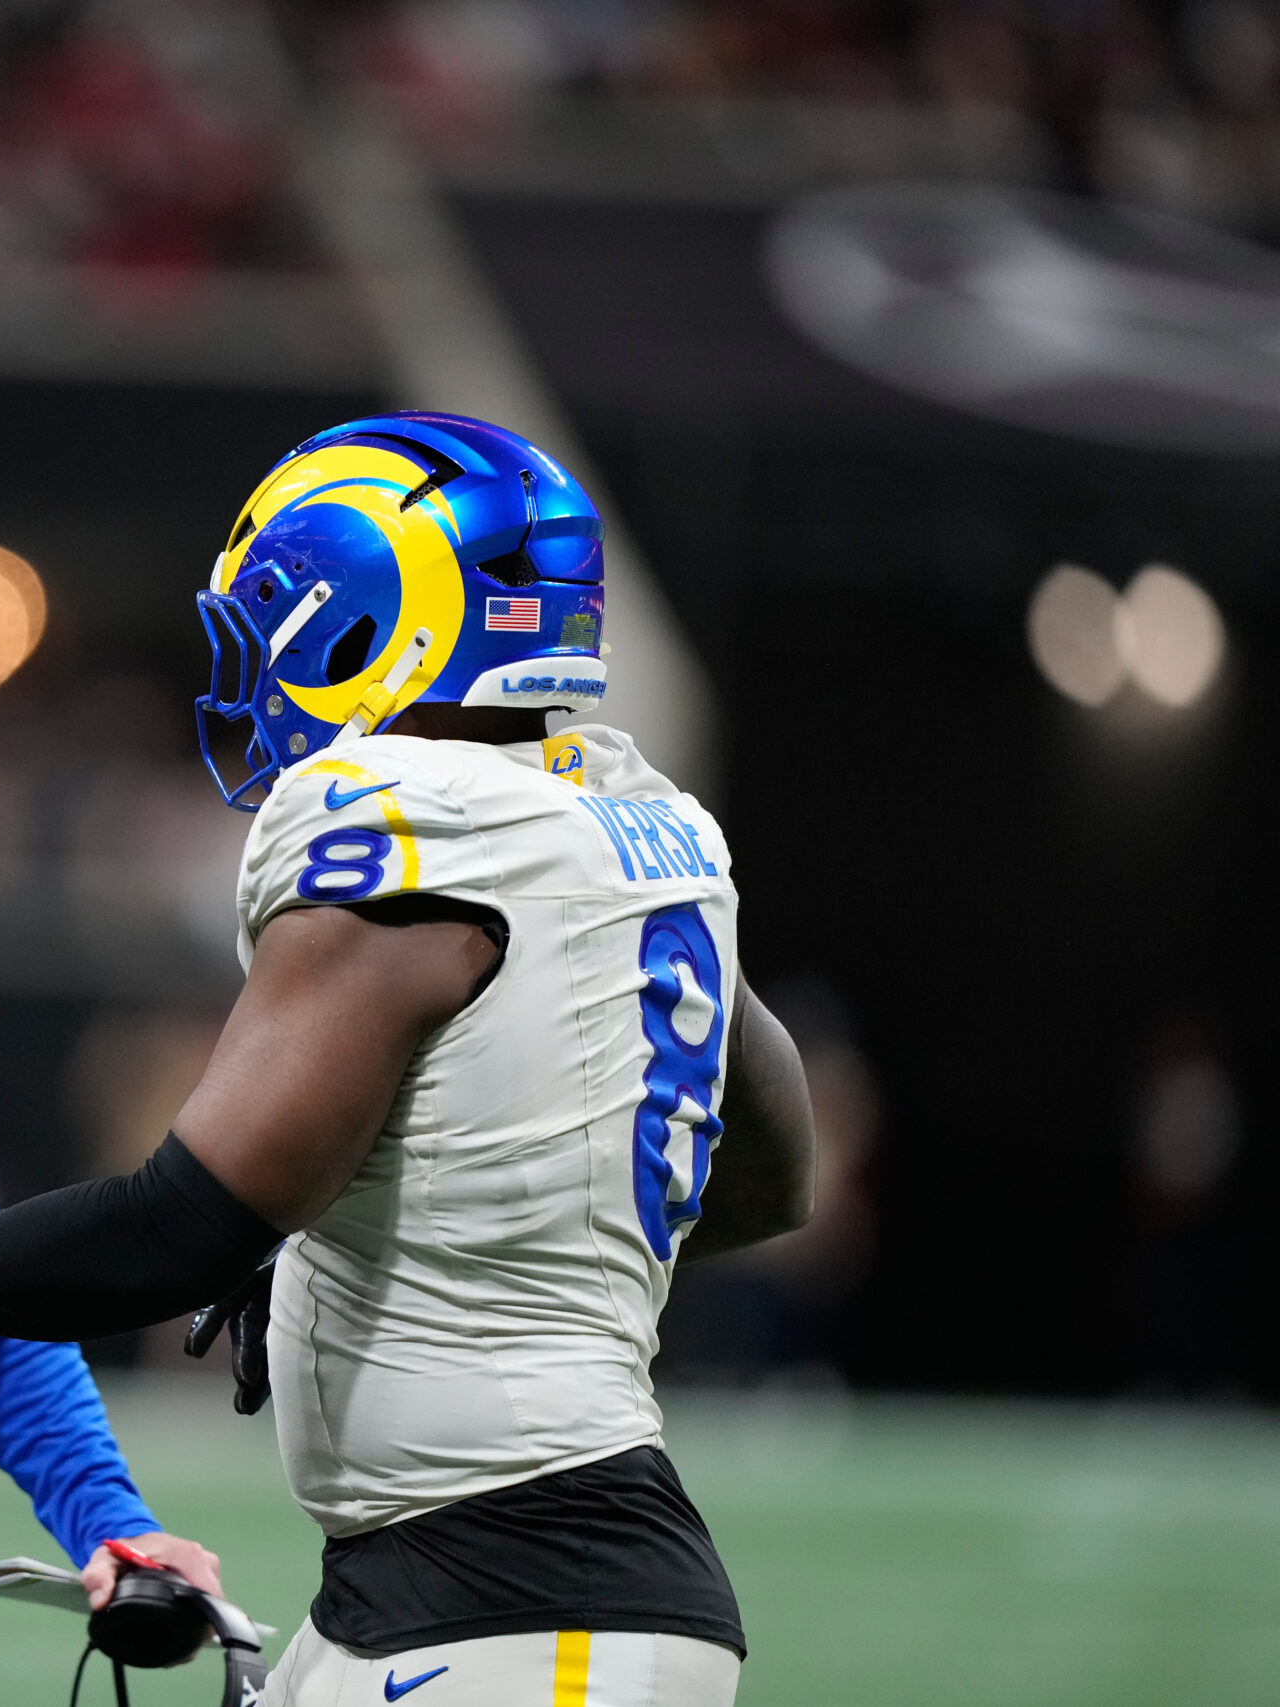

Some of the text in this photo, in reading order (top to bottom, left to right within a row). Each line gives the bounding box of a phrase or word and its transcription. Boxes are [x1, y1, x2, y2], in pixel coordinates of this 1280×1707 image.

[501, 675, 607, 699] LOS ANGE
[551, 744, 583, 775] LA
[296, 827, 392, 902] 8
[576, 796, 718, 881] VERSE
[632, 902, 724, 1262] 8
